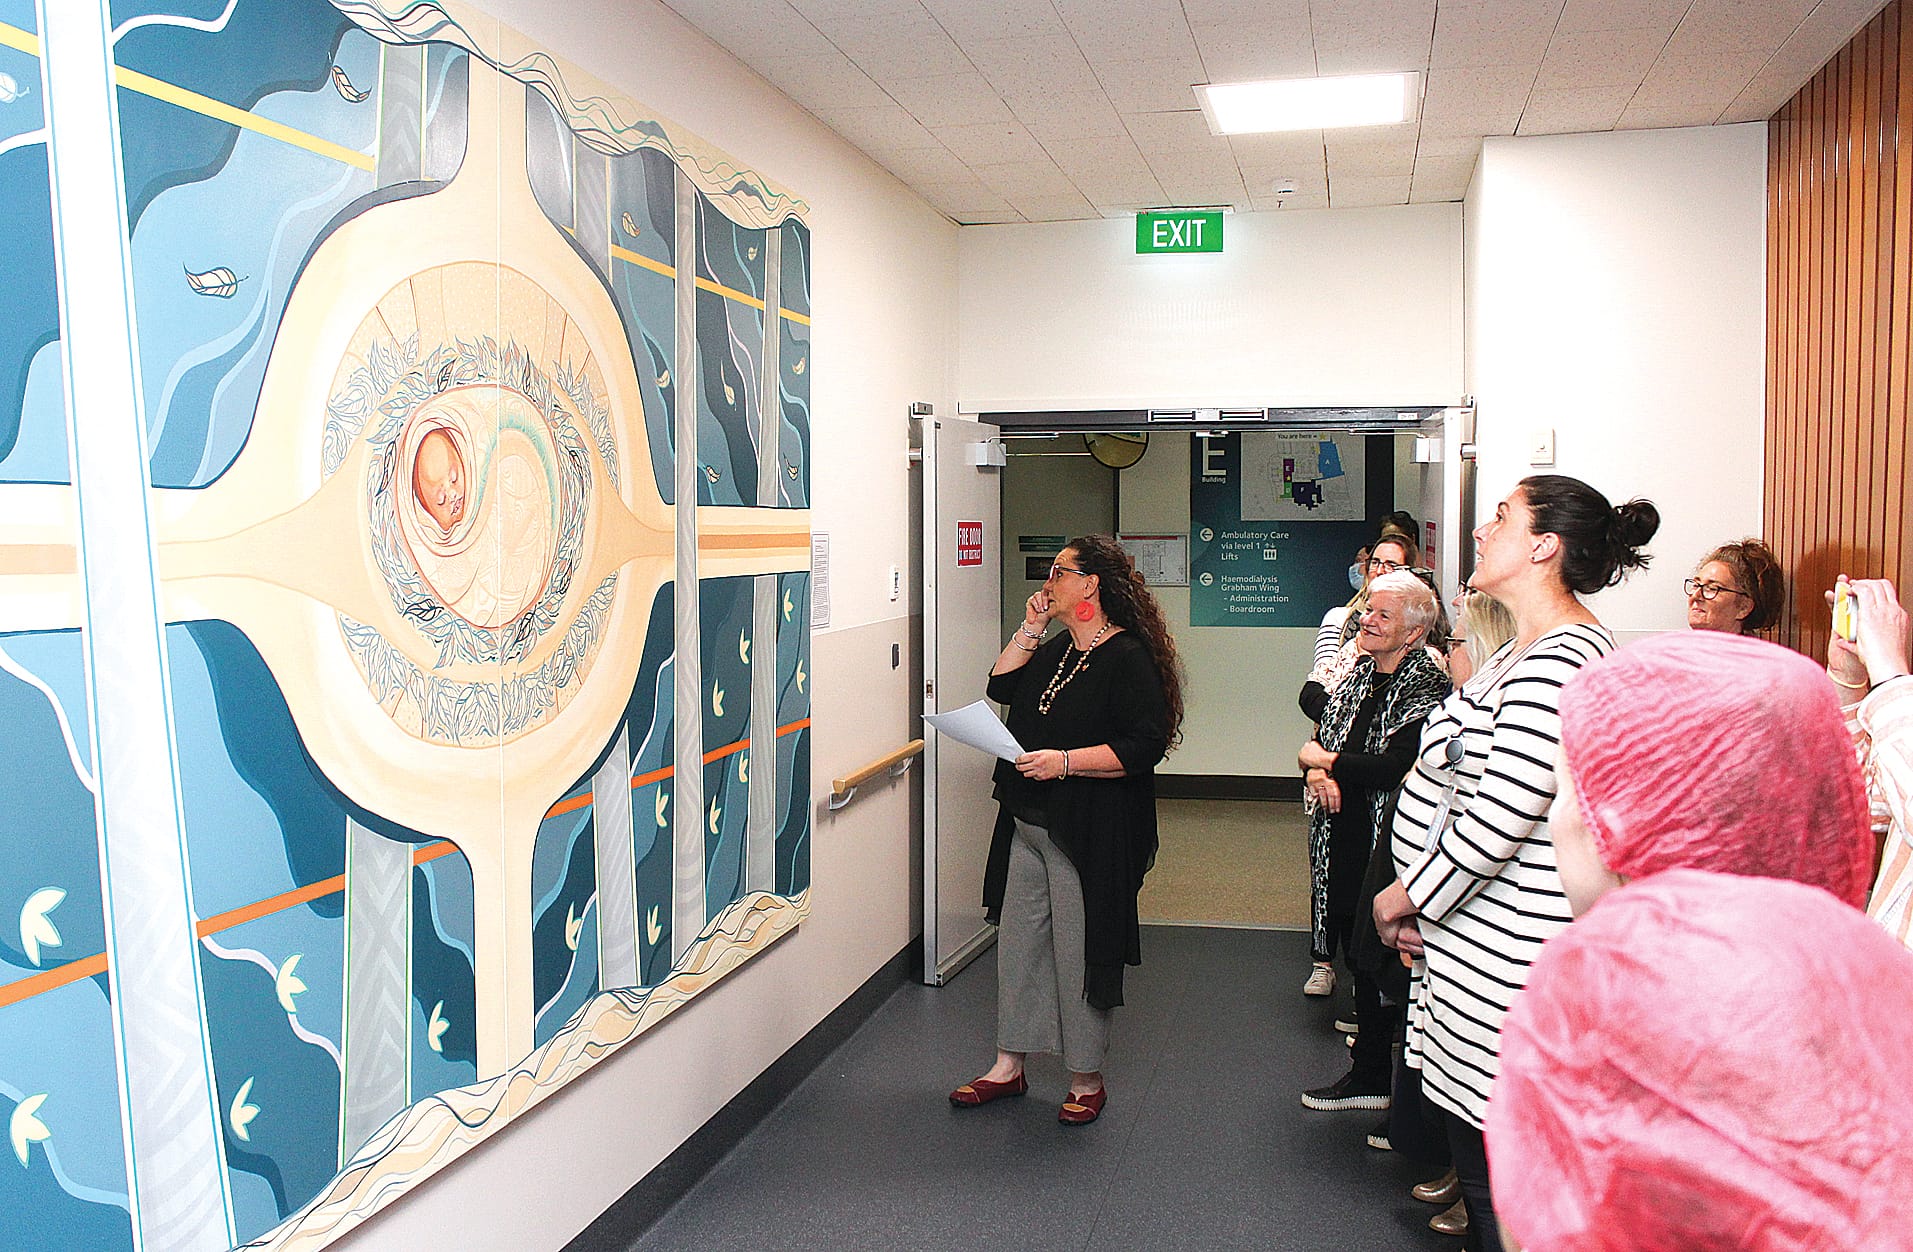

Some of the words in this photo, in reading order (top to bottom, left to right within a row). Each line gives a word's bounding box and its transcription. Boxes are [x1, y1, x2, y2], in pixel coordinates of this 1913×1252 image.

[1153, 219, 1206, 248] EXIT
[1203, 433, 1226, 475] E
[959, 528, 968, 545] FIRE
[1221, 531, 1268, 541] Ambulatory
[1270, 531, 1290, 540] Care
[1221, 541, 1233, 550] via
[1234, 541, 1254, 550] level
[1256, 542, 1260, 550] 1
[1221, 552, 1239, 561] Lifts
[1221, 575, 1278, 584] Haemodialysis
[1221, 583, 1257, 592] Grabham
[1259, 584, 1280, 594] Wing
[1229, 594, 1289, 603] Administration
[1229, 604, 1275, 613] Boardroom
